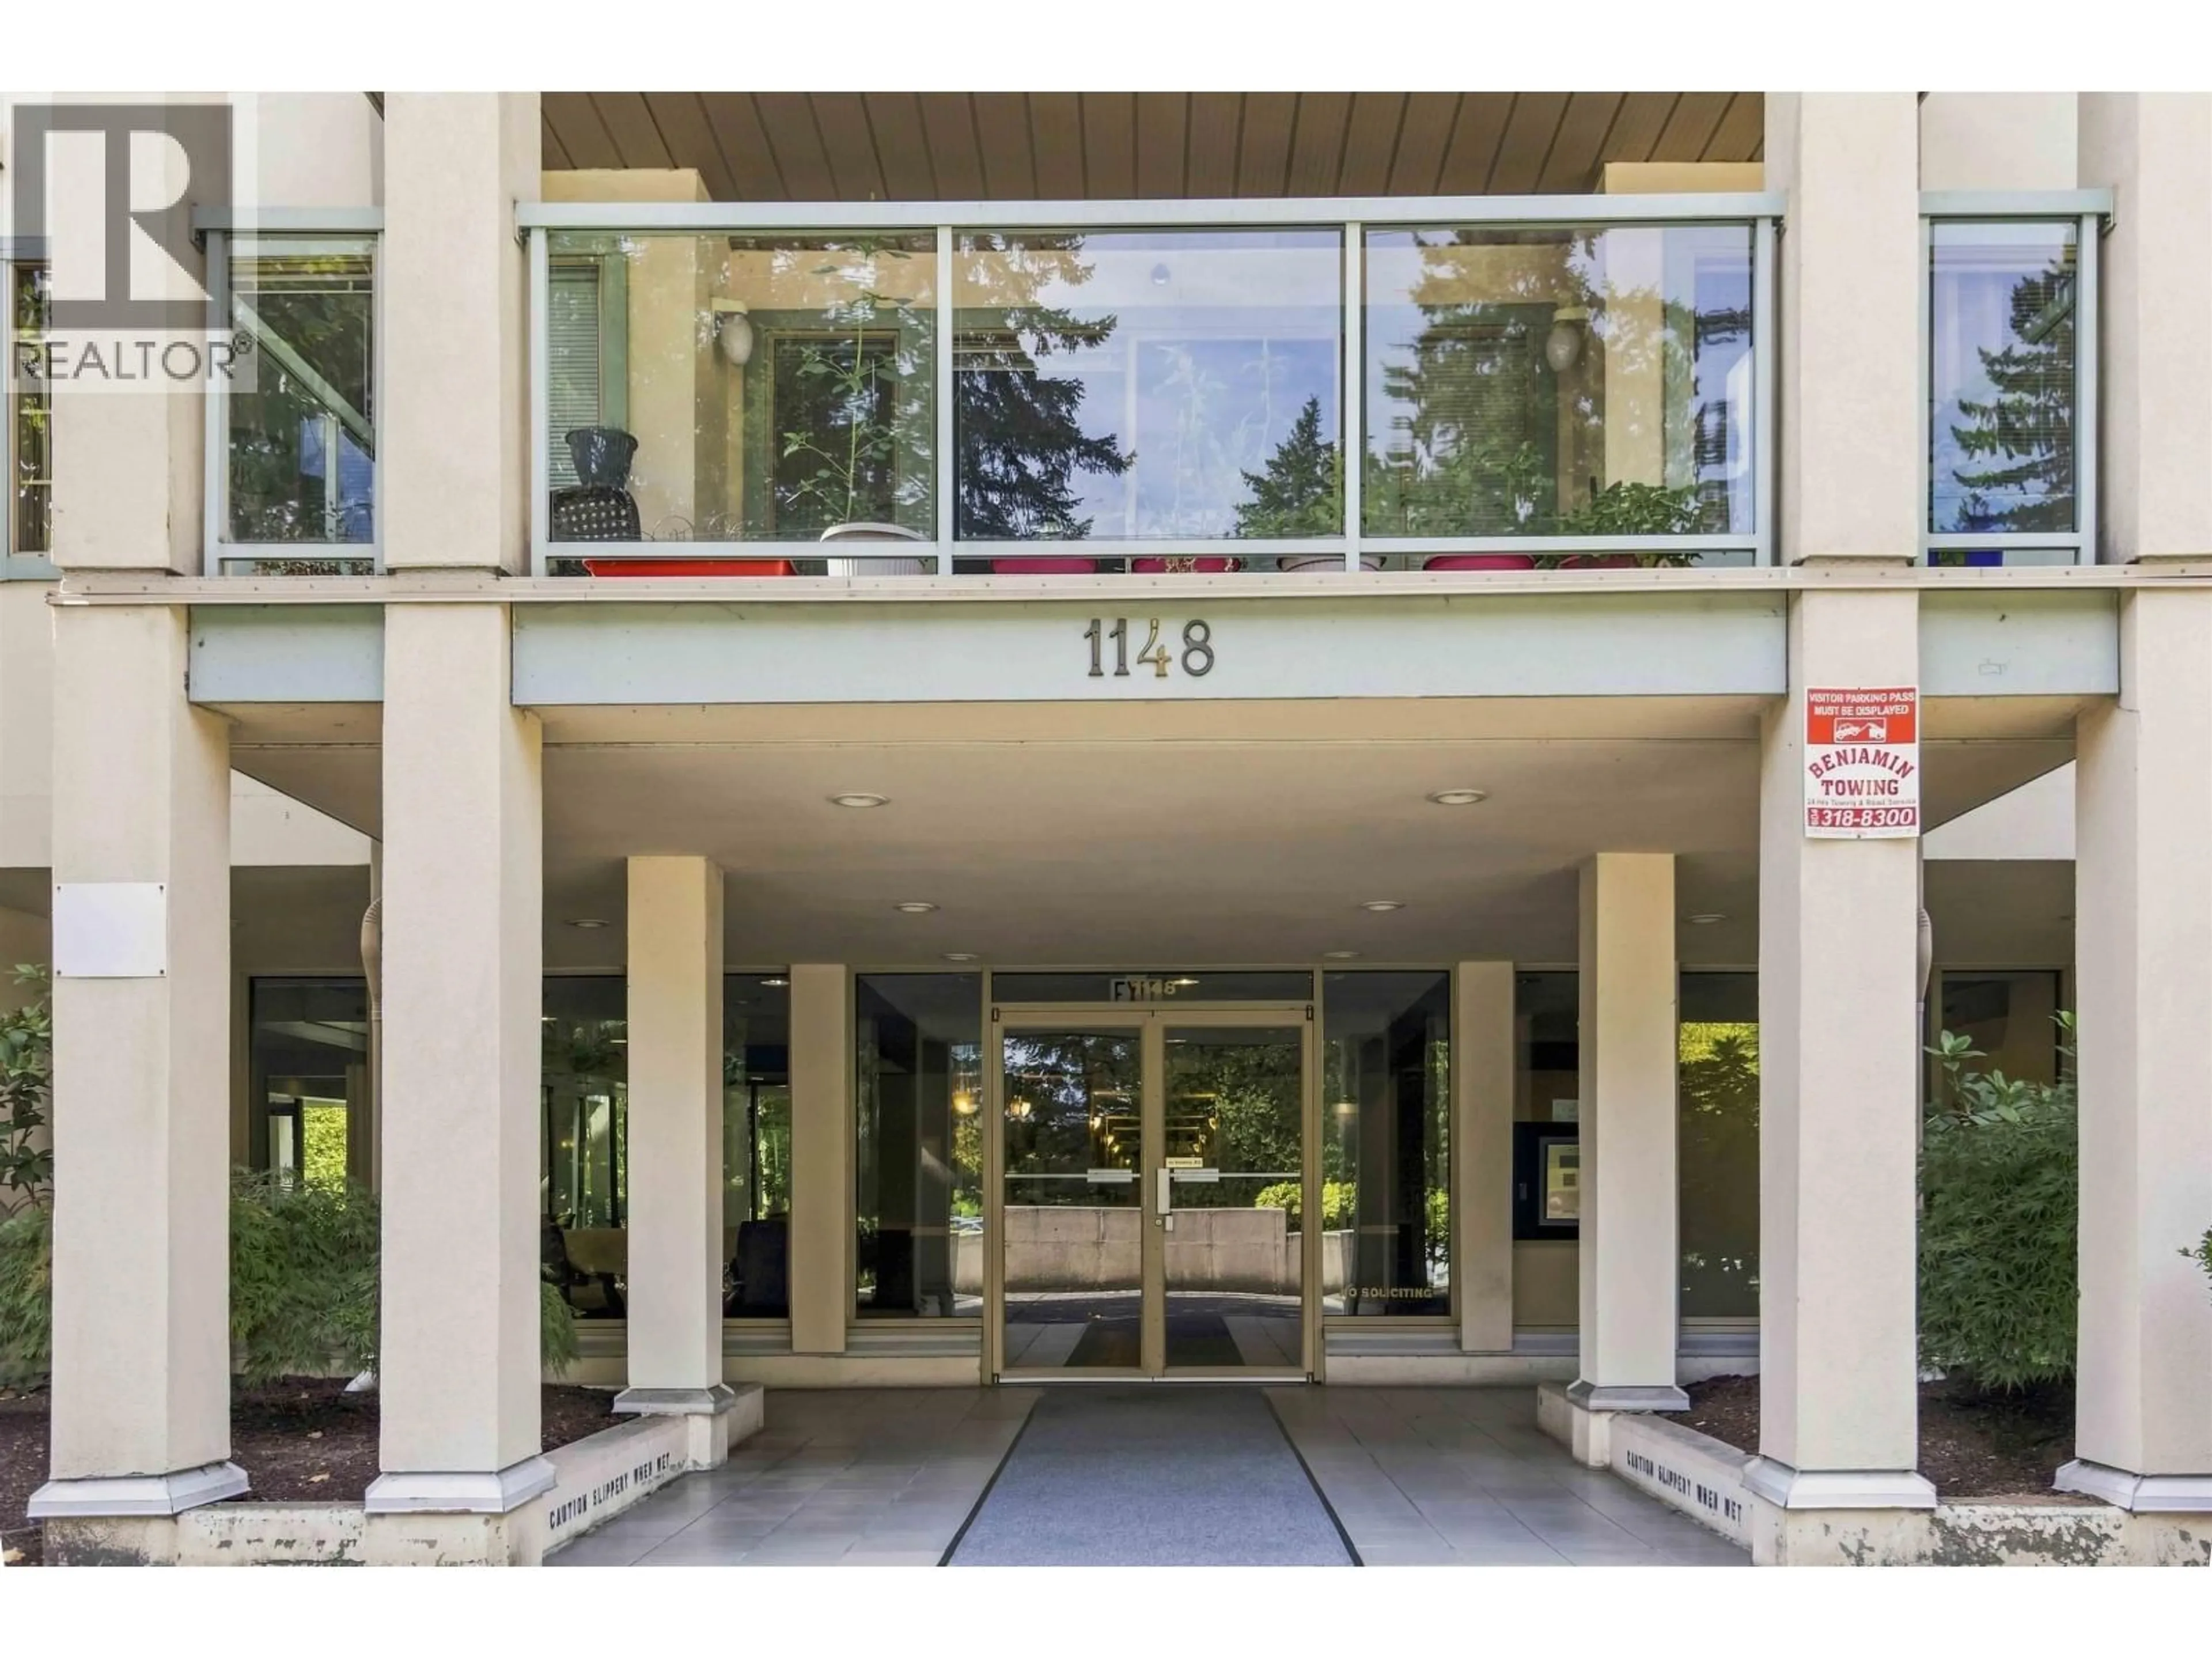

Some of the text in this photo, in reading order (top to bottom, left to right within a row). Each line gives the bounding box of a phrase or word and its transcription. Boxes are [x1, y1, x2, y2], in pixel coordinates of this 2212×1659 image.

[1084, 618, 1214, 677] 1148
[1809, 692, 1914, 702] VISITOR PARKING PASS
[1814, 705, 1910, 715] MUST BE DISPLAYED
[1808, 748, 1915, 779] BENJAMIN
[1821, 779, 1899, 796] TOWING
[1821, 808, 1914, 827] 318-8300
[1361, 1287, 1433, 1298] SOLICITING
[550, 1452, 670, 1529] CAUTION SLIPPERY WHEN WET
[1627, 1450, 1743, 1522] CAUTION SLIPPERY WHEN WET
